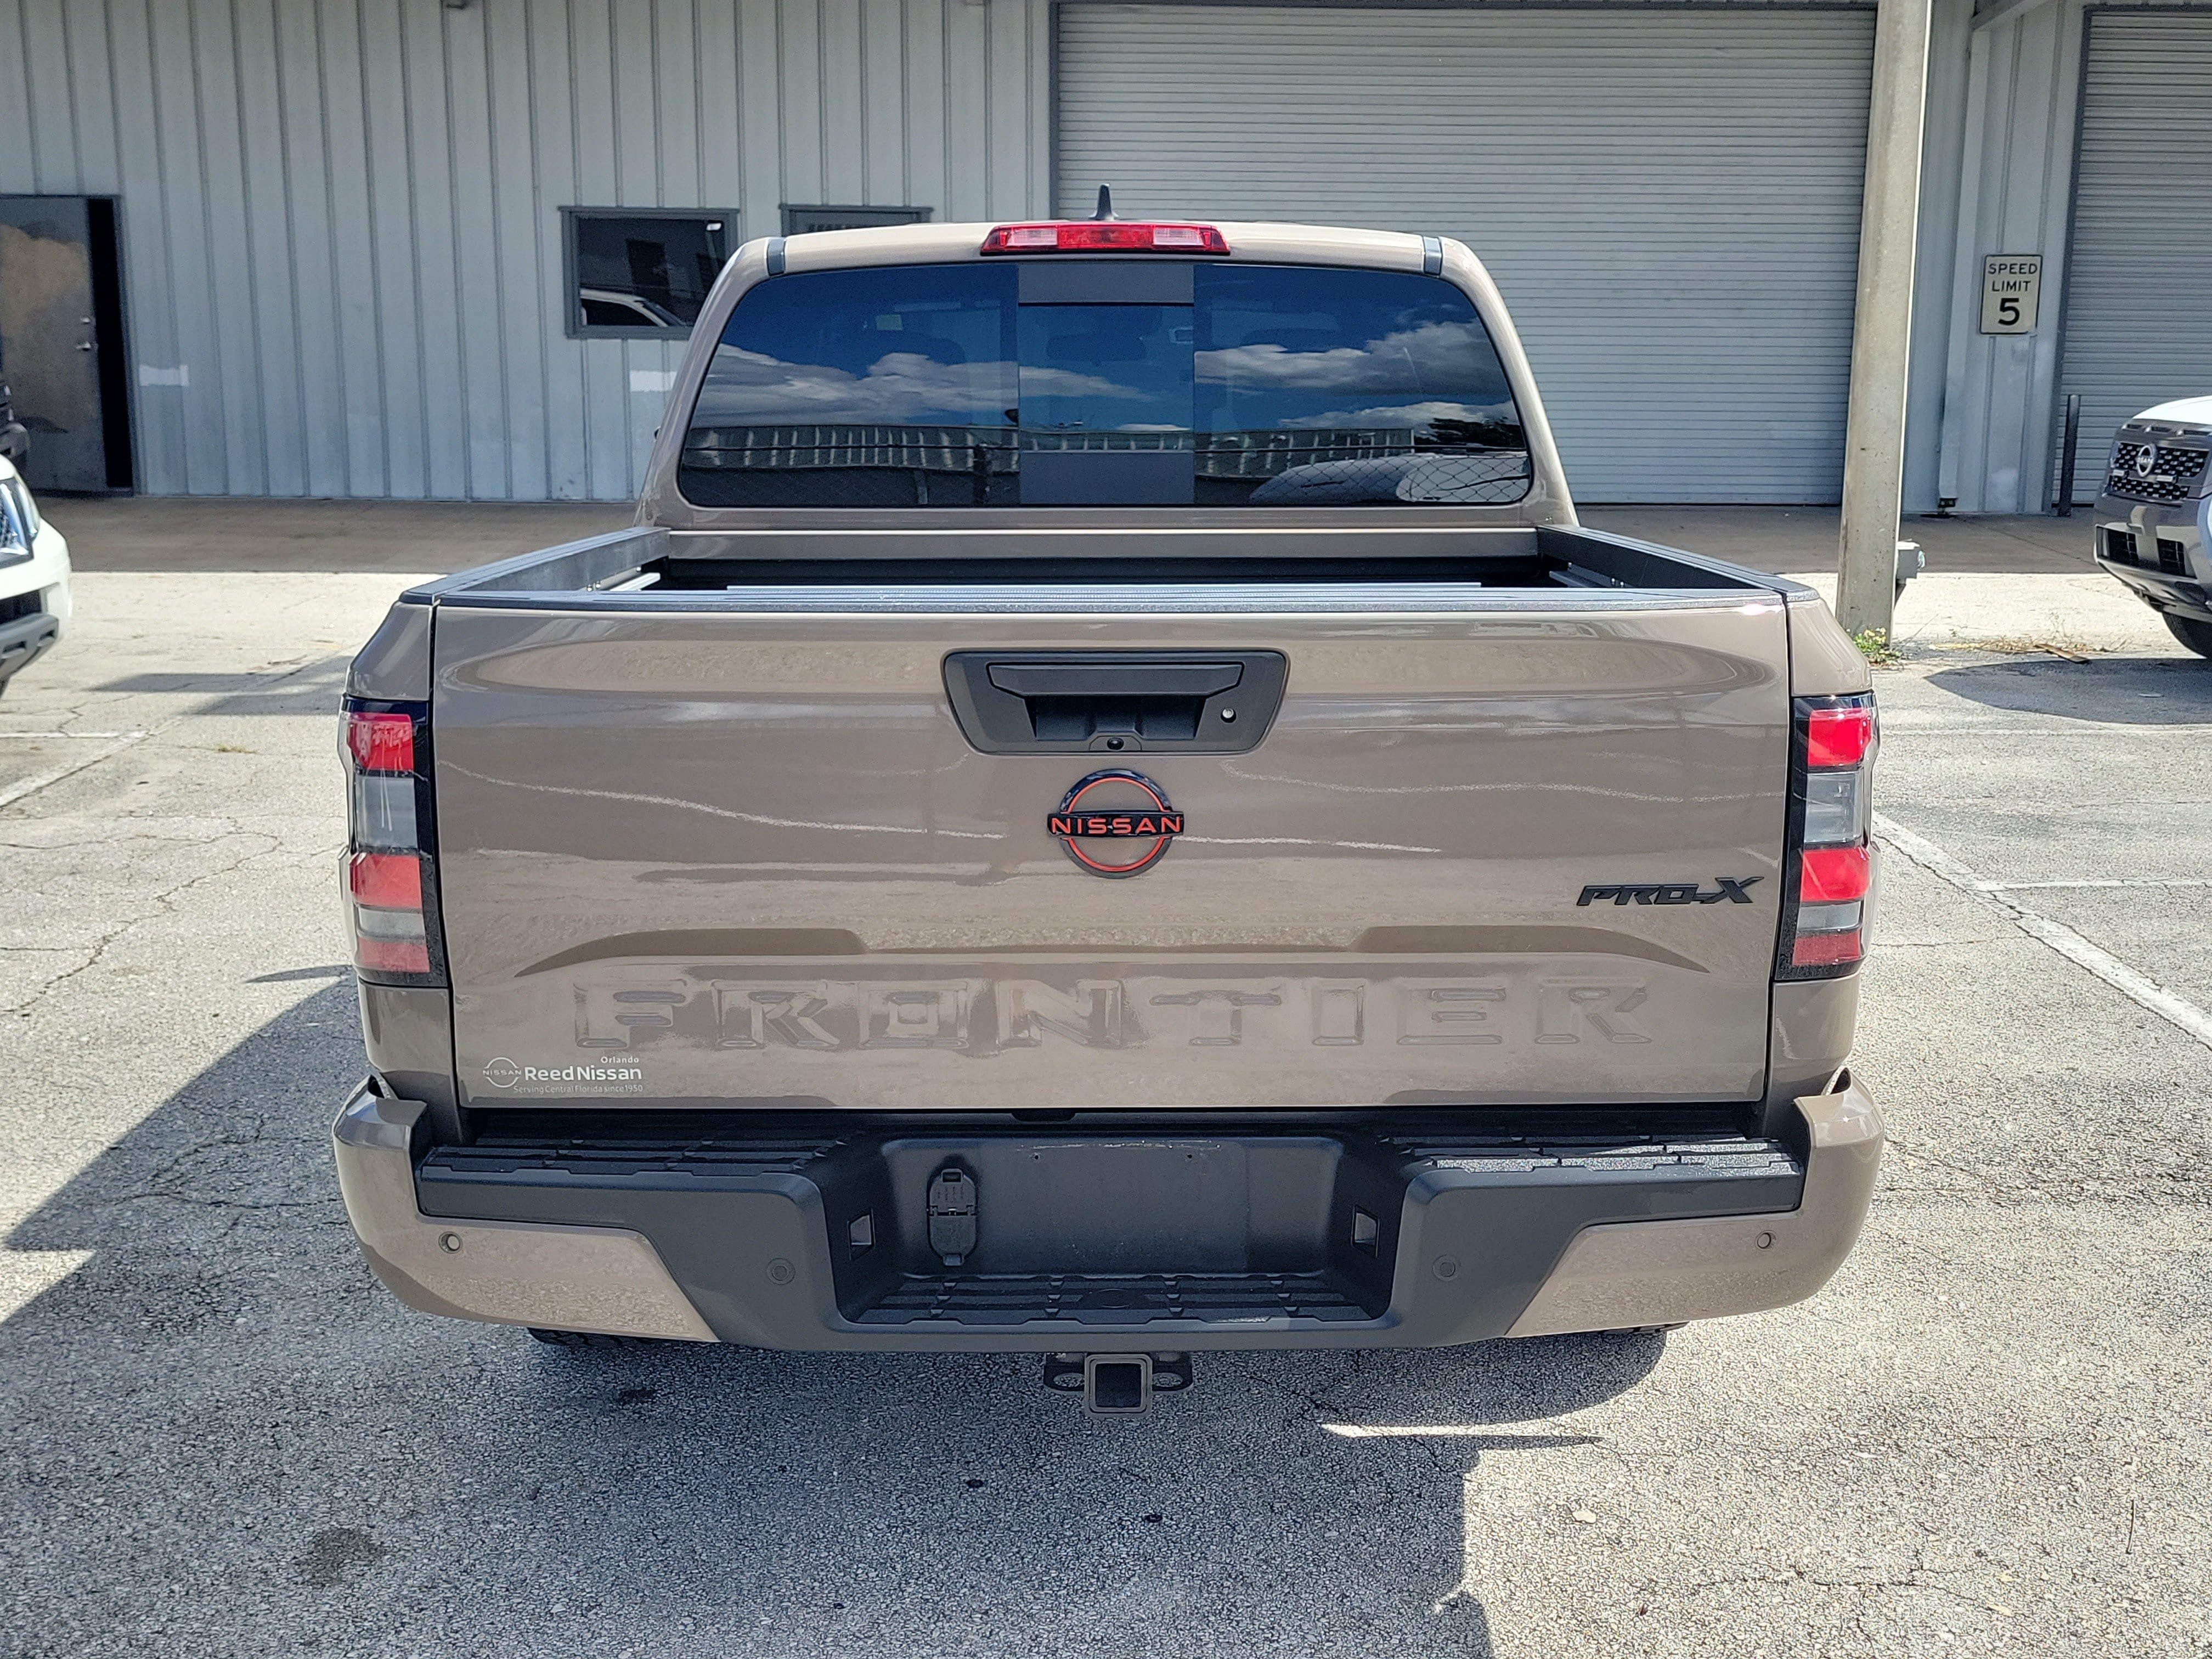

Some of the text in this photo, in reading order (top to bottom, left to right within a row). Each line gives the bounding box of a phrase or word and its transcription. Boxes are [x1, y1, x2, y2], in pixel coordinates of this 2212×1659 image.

[1988, 263, 2038, 275] SPEED
[1991, 280, 2031, 292] LIMIT
[1997, 297, 2020, 326] 5
[1051, 816, 1181, 834] NISSAN
[573, 978, 1652, 1049] FRONTIER
